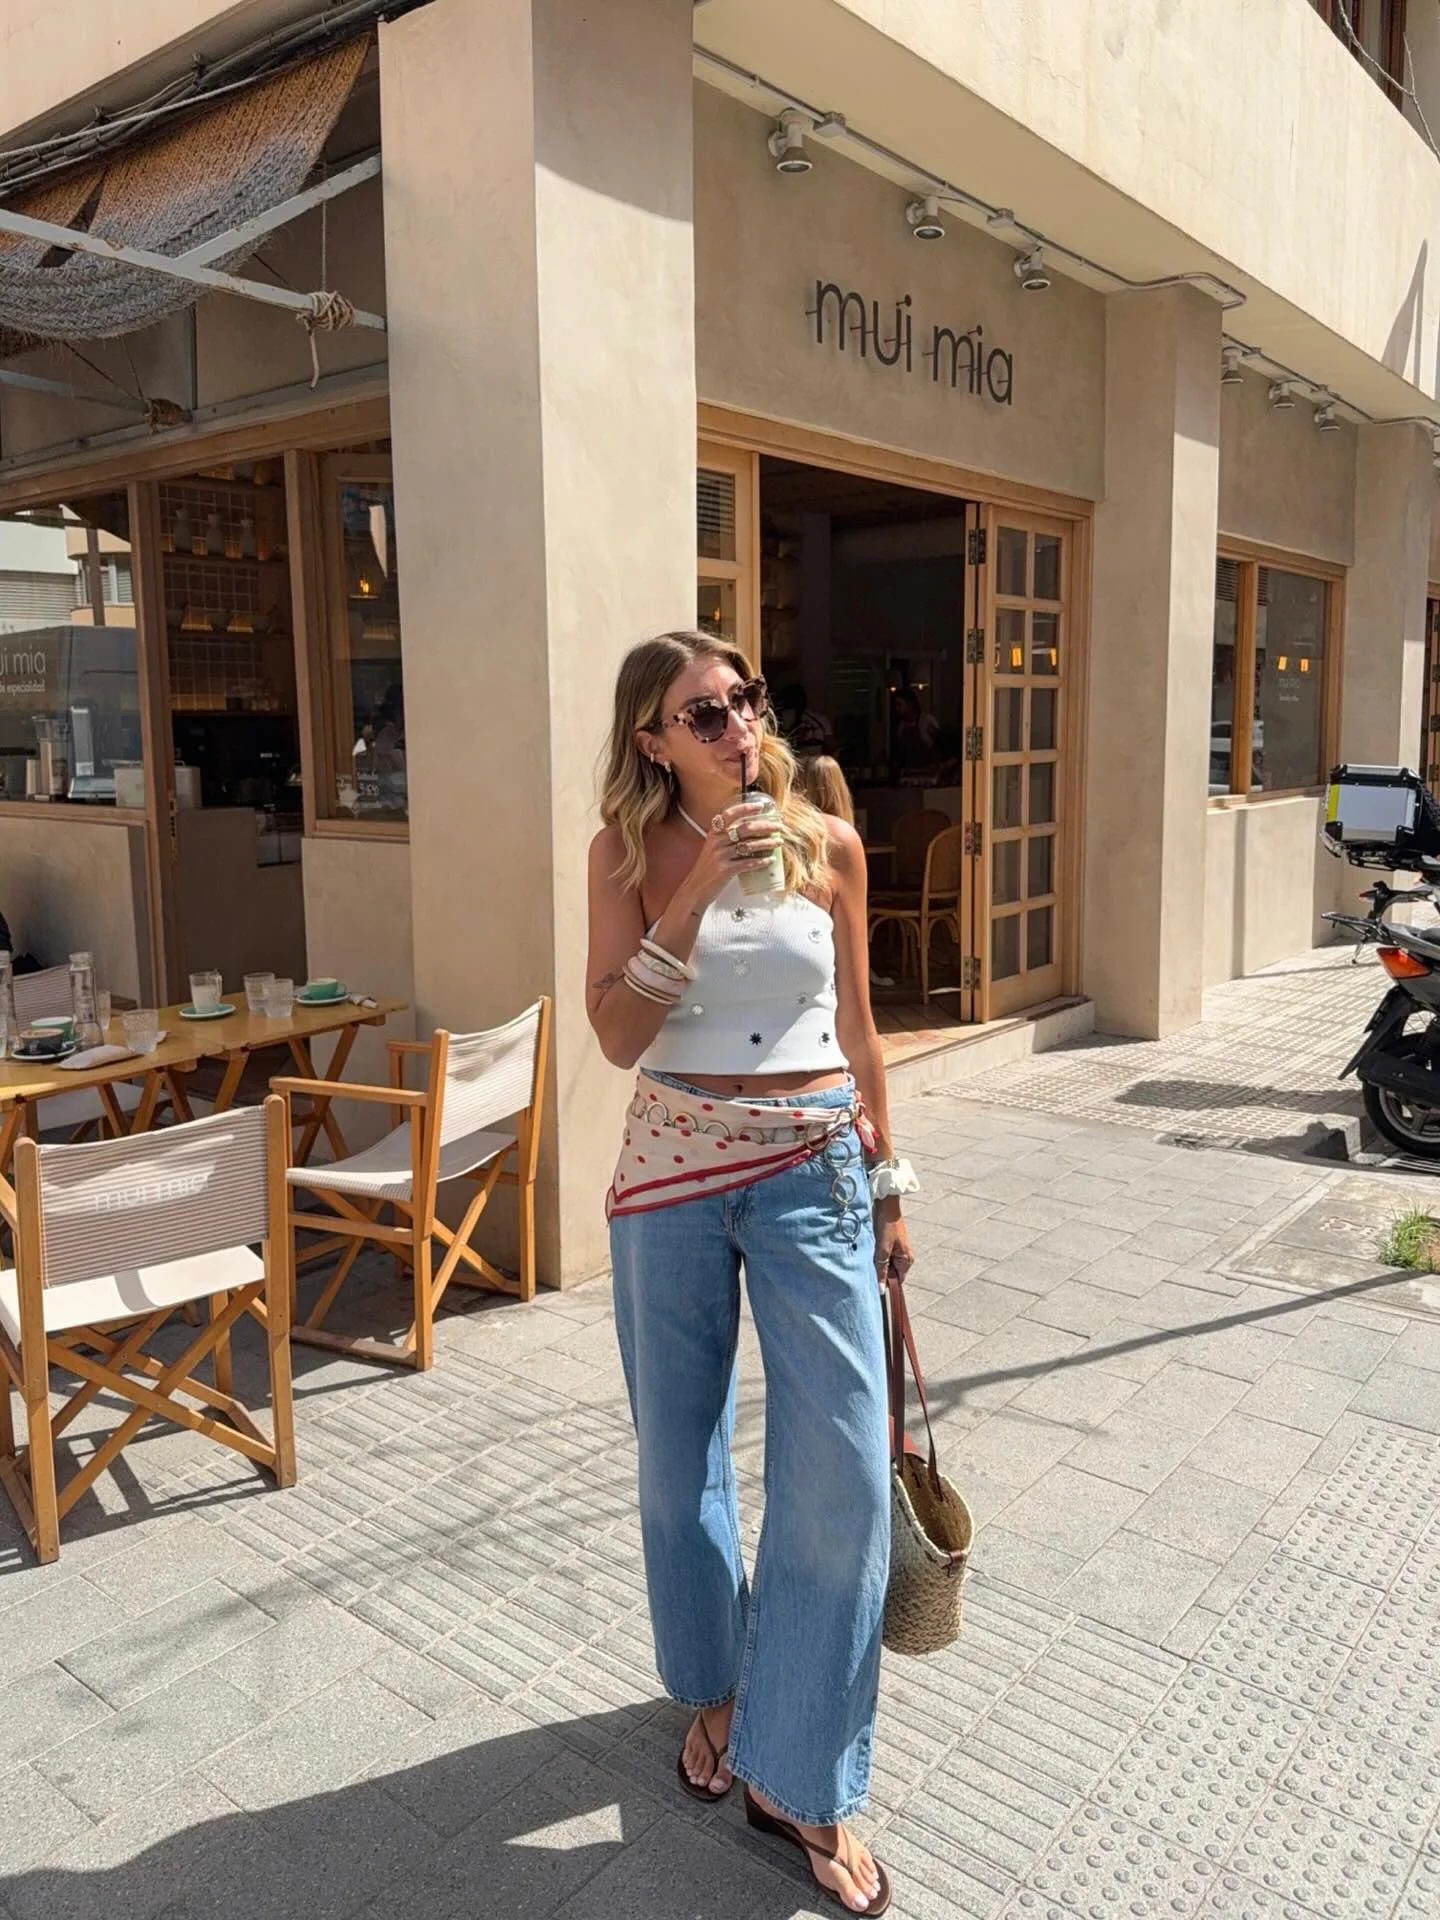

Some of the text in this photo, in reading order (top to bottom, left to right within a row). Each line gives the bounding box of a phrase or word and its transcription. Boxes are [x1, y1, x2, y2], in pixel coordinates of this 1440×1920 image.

[815, 279, 1012, 405] mui mia
[13, 645, 46, 675] mia
